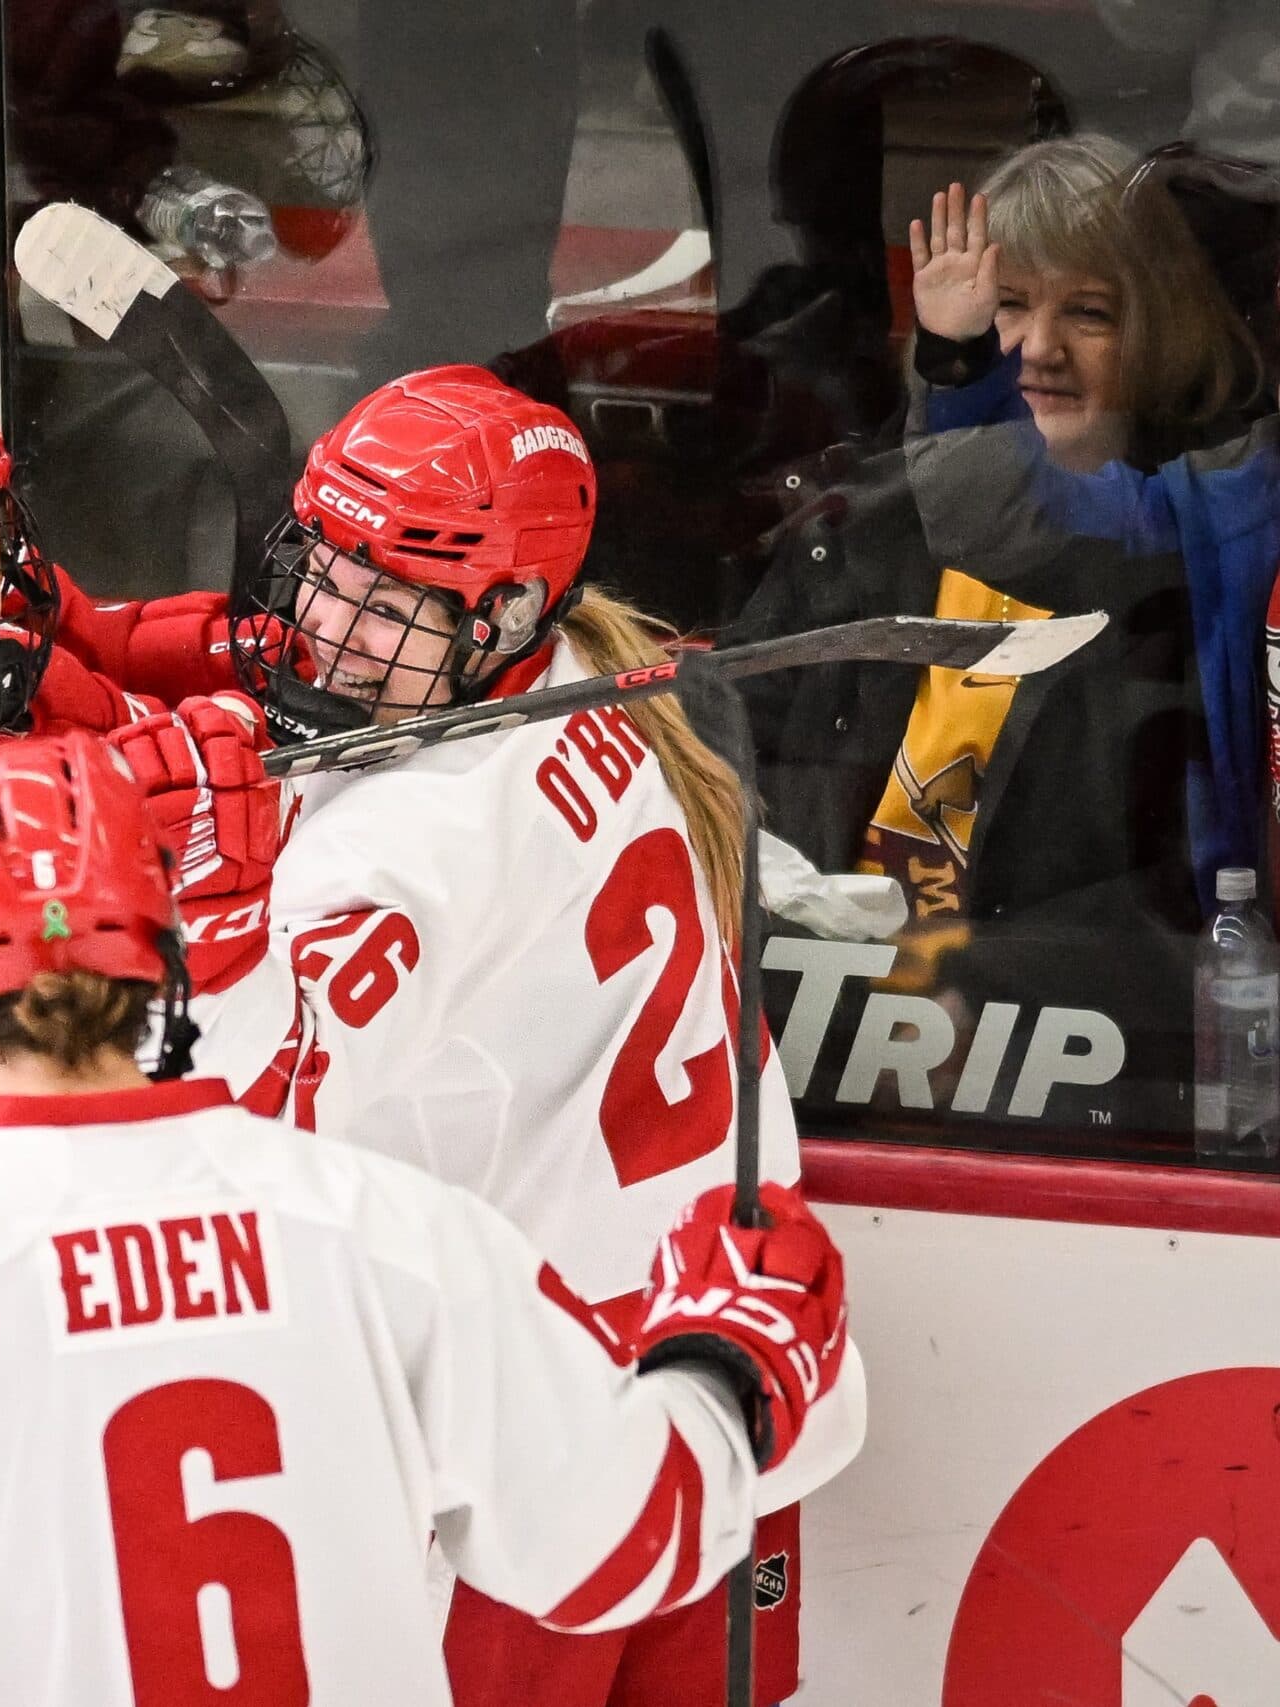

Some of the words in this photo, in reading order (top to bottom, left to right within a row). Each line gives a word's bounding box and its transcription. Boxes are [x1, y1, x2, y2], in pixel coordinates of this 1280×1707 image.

[511, 426, 587, 465] BADGERS
[318, 485, 387, 530] CCM
[31, 850, 57, 890] 6
[290, 908, 420, 1029] 26
[759, 936, 1125, 1118] TRIP
[1089, 1110, 1112, 1125] TM
[52, 1210, 272, 1335] EDEN
[100, 1377, 311, 1707] 6
